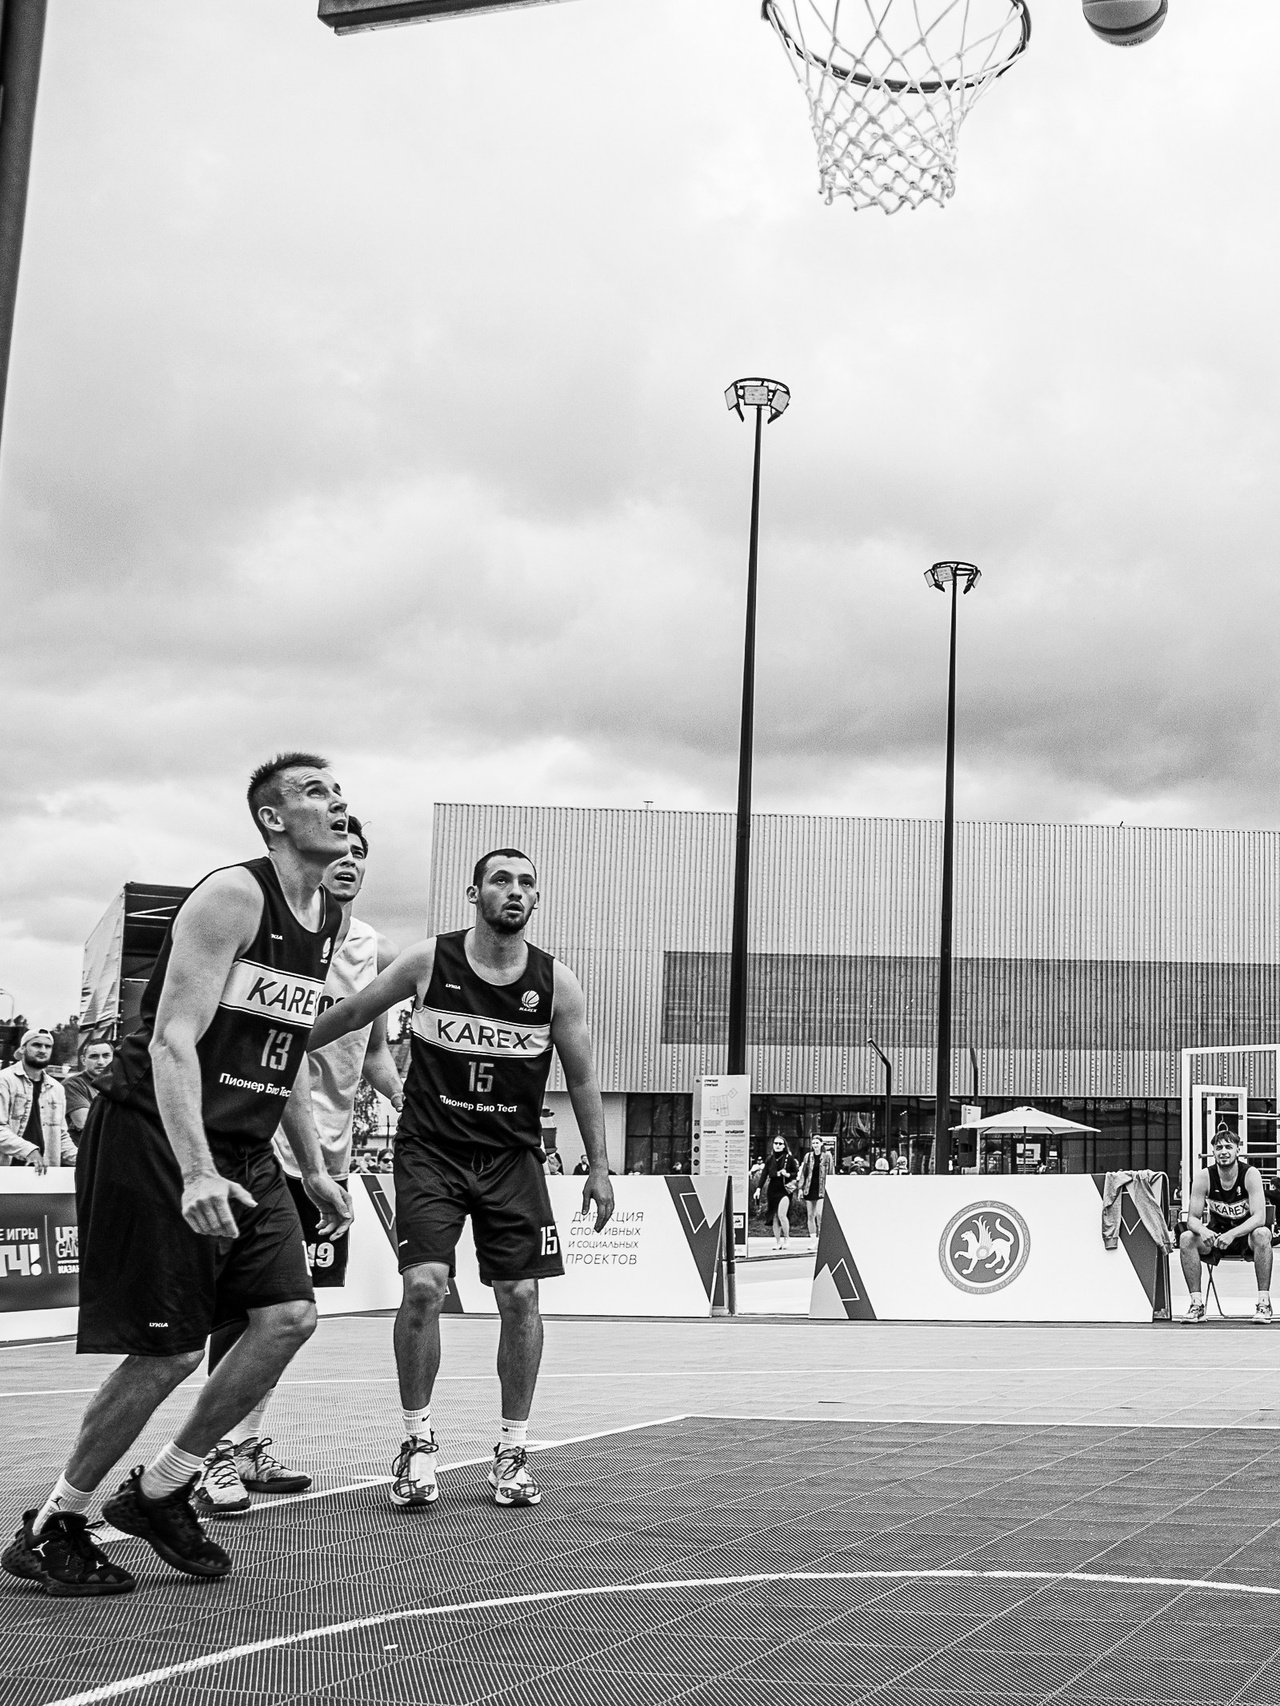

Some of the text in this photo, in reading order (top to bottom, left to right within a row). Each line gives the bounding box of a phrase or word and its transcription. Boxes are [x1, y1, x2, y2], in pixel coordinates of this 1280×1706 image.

[437, 1018, 532, 1050] KAREX
[260, 1028, 294, 1071] 13
[219, 1072, 265, 1093] Пионер
[279, 1086, 292, 1098] Тес
[468, 1061, 495, 1093] 15
[439, 1094, 518, 1113] Пионер Био Тест
[1214, 1202, 1248, 1216] KAREX
[572, 1211, 644, 1224] ДИРЦИЯ
[6, 1228, 39, 1241] ИГРЫ
[570, 1227, 641, 1236] СПОИВНЫХ
[540, 1225, 559, 1256] 15
[568, 1240, 639, 1249] И СОЦИАЛЬНЫХ
[565, 1253, 638, 1265] ПРОЕКТОВ
